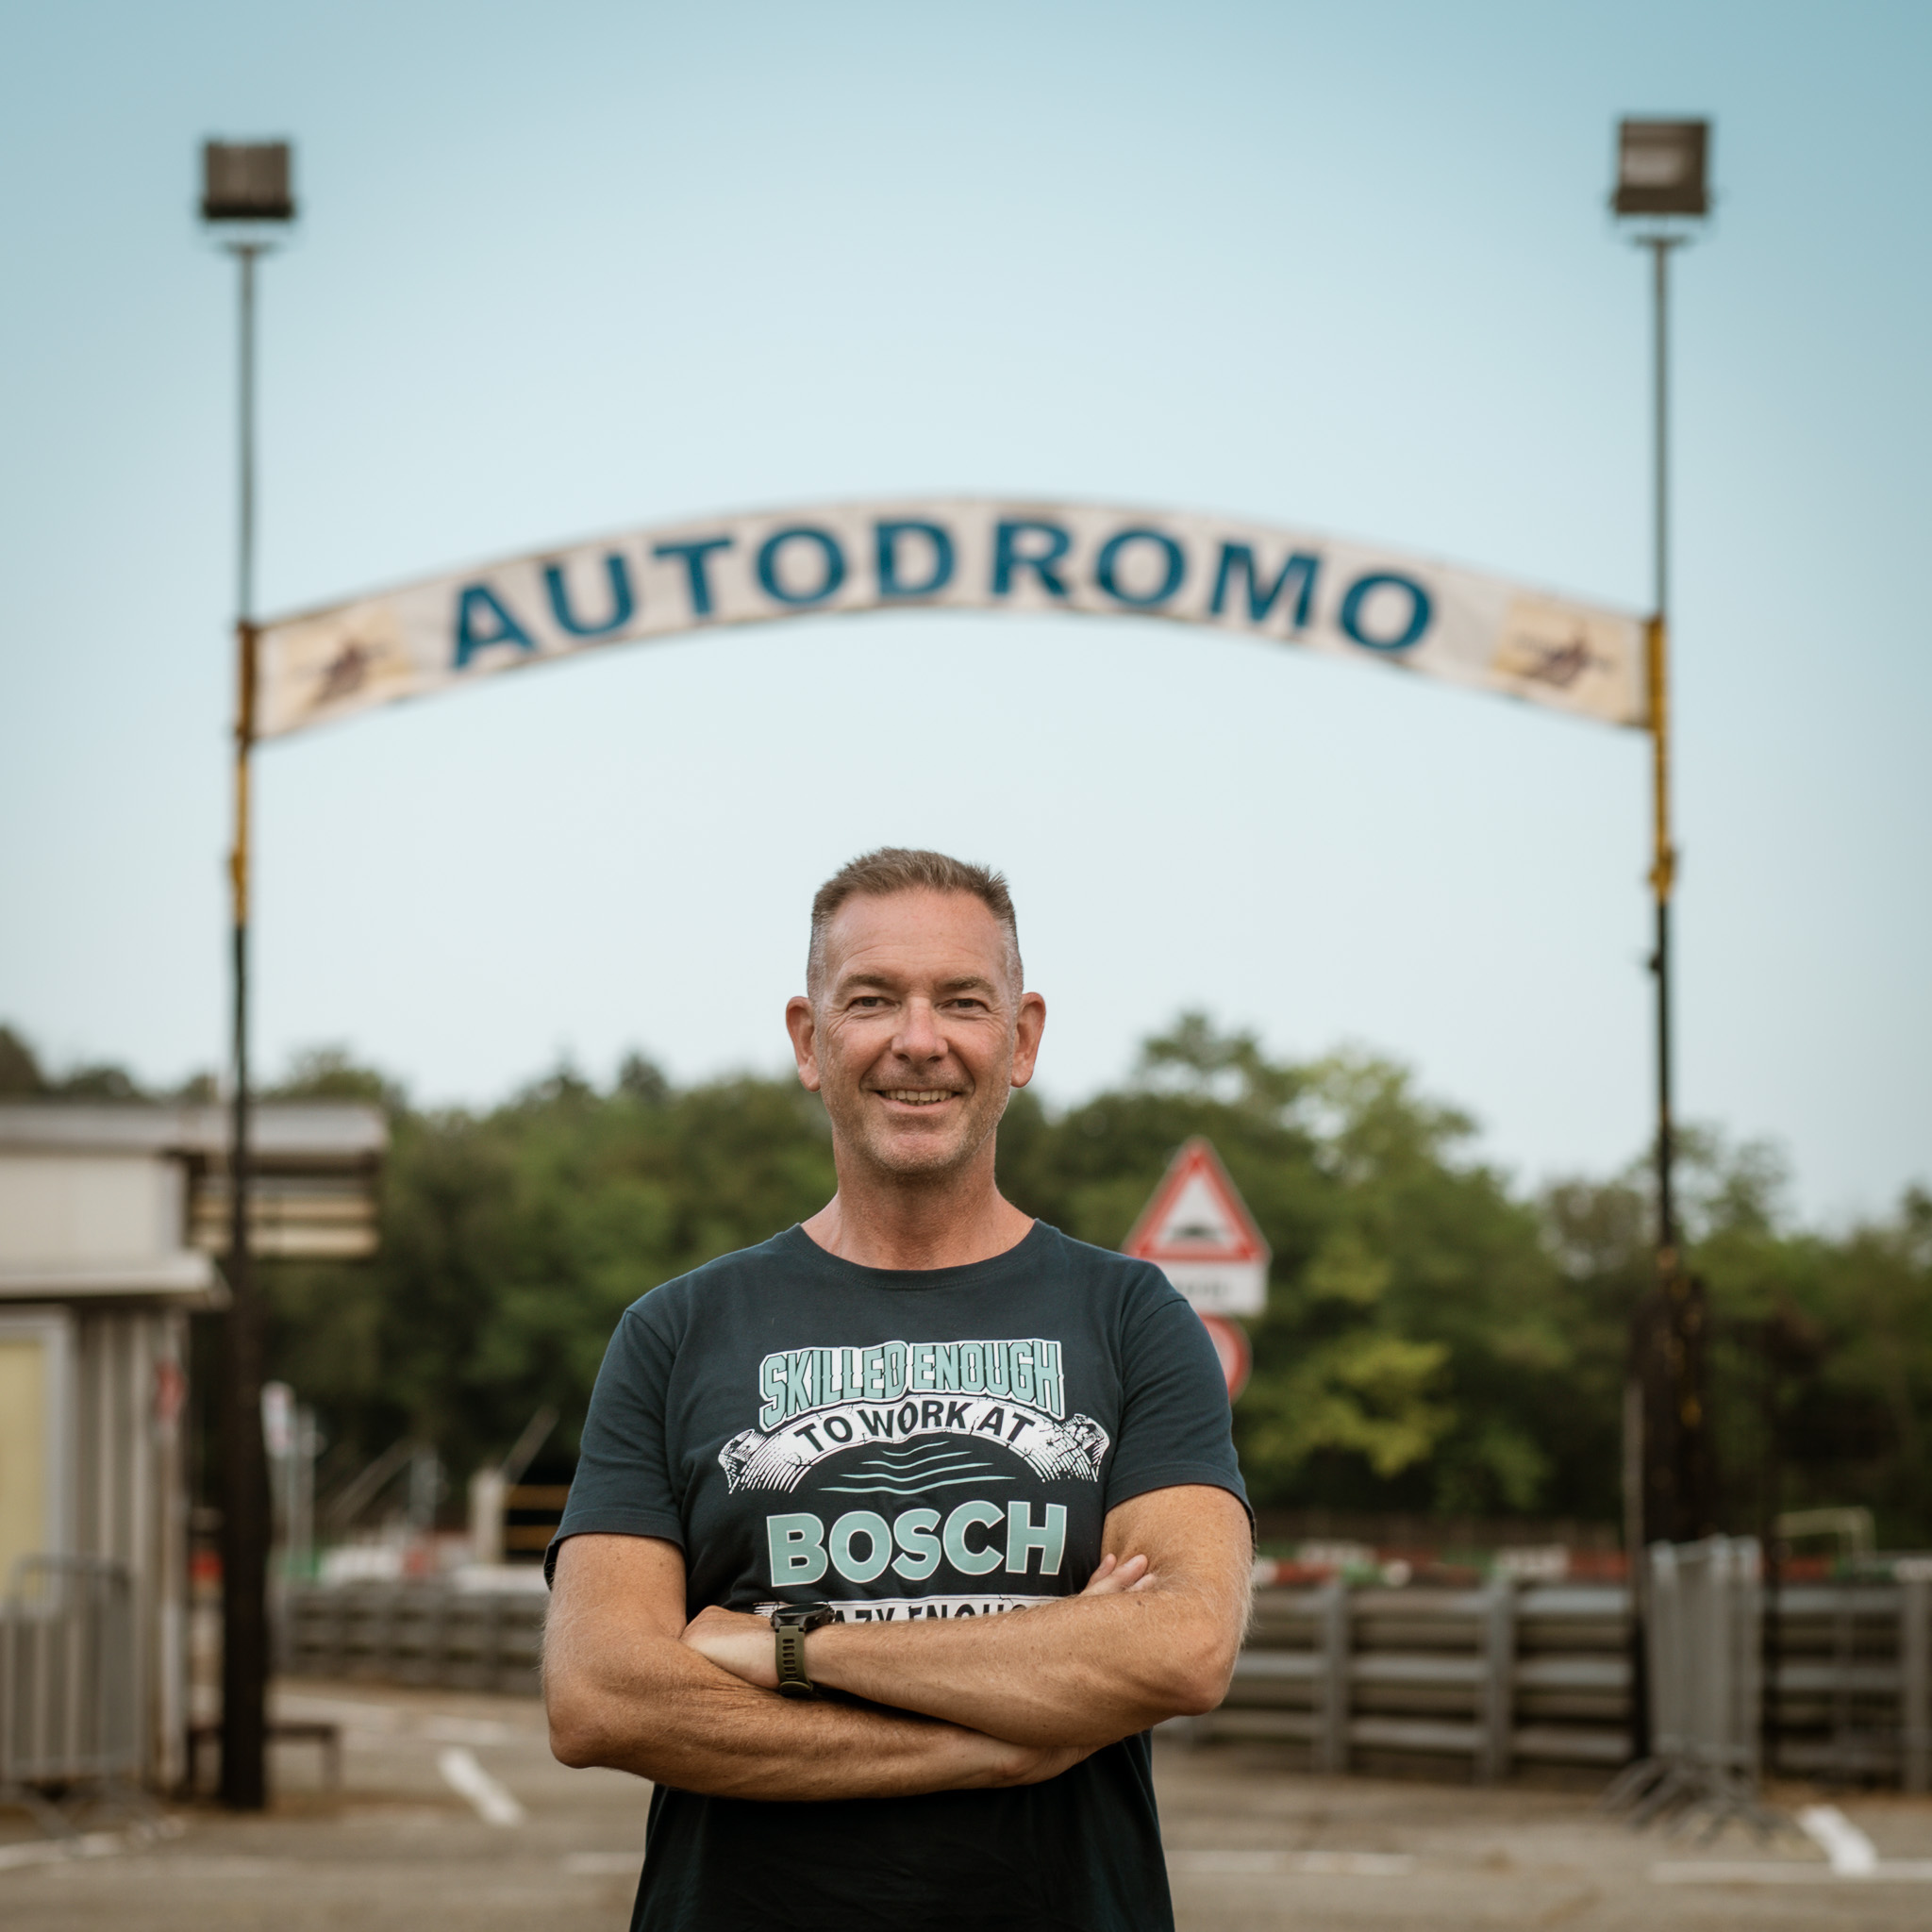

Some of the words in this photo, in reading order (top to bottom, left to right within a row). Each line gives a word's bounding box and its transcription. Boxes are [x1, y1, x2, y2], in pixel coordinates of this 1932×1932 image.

[448, 515, 1438, 673] AUTODROMO
[759, 1341, 908, 1432] SKILLED
[908, 1339, 1064, 1421] ENOUGH
[793, 1416, 853, 1452] TO
[857, 1401, 974, 1440] WORK
[976, 1407, 1037, 1444] AT
[767, 1501, 1067, 1587] BOSCH
